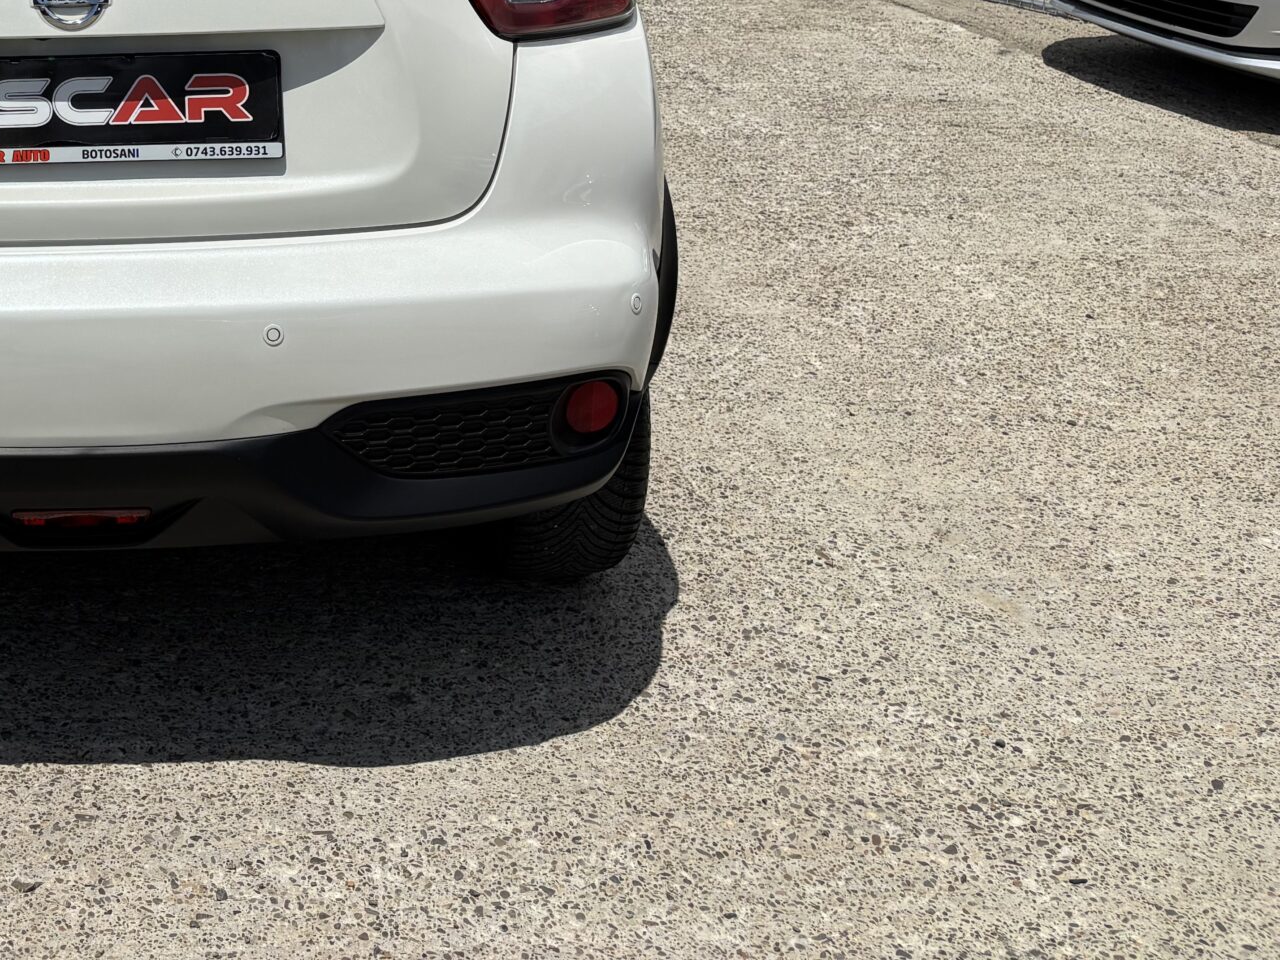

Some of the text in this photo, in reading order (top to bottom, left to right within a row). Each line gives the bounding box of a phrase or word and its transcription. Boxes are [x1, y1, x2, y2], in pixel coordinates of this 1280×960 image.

[12, 149, 51, 162] AUTO
[82, 148, 140, 159] BOTOSANI
[186, 145, 269, 157] 0743.639.931
